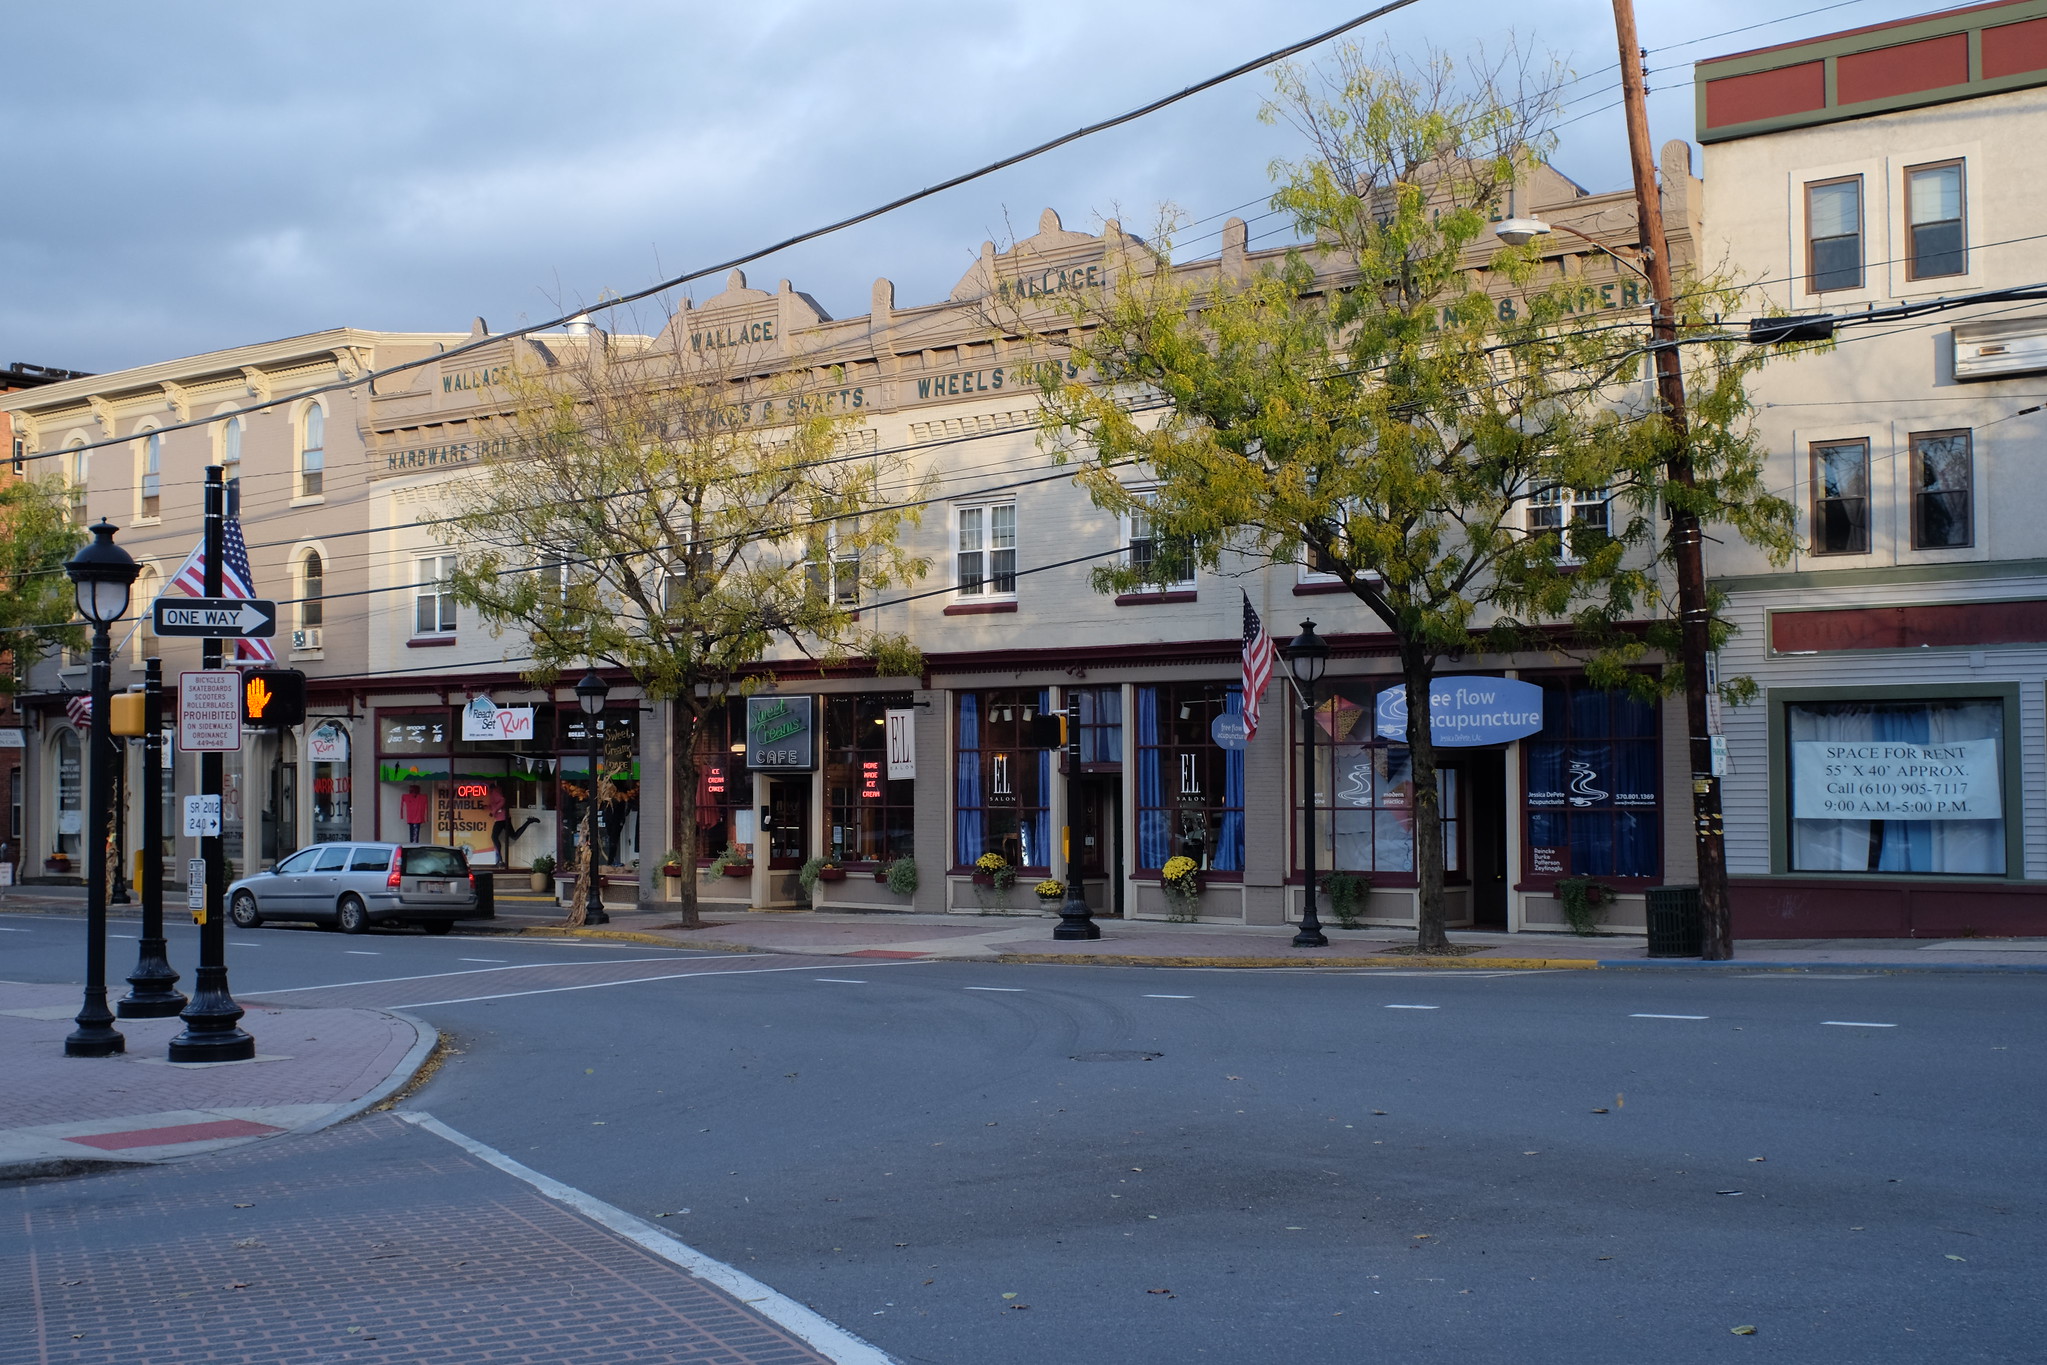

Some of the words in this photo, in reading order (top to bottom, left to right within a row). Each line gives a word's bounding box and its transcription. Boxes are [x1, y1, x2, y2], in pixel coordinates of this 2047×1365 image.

[691, 321, 778, 351] WALLACE.
[918, 368, 1004, 399] WHEELS
[388, 445, 467, 470] HARDWARE
[167, 610, 199, 624] ONE
[205, 611, 240, 625] WAY
[1431, 694, 1451, 706] ee
[1456, 689, 1496, 709] flow
[184, 711, 236, 720] PROHIBITED
[473, 709, 495, 719] Ready
[750, 699, 788, 731] Sweet
[1430, 711, 1540, 731] acupuncture
[482, 718, 496, 729] Set
[496, 711, 529, 738] Run
[756, 718, 804, 745] Creams
[312, 741, 335, 755] Run
[1826, 747, 1879, 760] SPACE
[1884, 748, 1917, 760] FOR
[1923, 747, 1966, 760] RENT
[756, 749, 798, 765] CAFE
[1180, 753, 1201, 793] E.L.
[1853, 765, 1864, 777] X
[1896, 764, 1969, 777] APPROX.
[458, 785, 487, 797] OPEN
[1826, 782, 1854, 794] Call
[1859, 783, 1897, 796] (610)
[1901, 783, 1968, 795] 905-7117
[190, 802, 200, 813] SR
[203, 802, 219, 813] 2012
[1824, 800, 1855, 812] 9:00
[1859, 801, 1932, 813] A.M.-5:00
[1937, 801, 1972, 813] P.M.
[189, 818, 207, 829] 240
[438, 821, 487, 832] CLASSIC!
